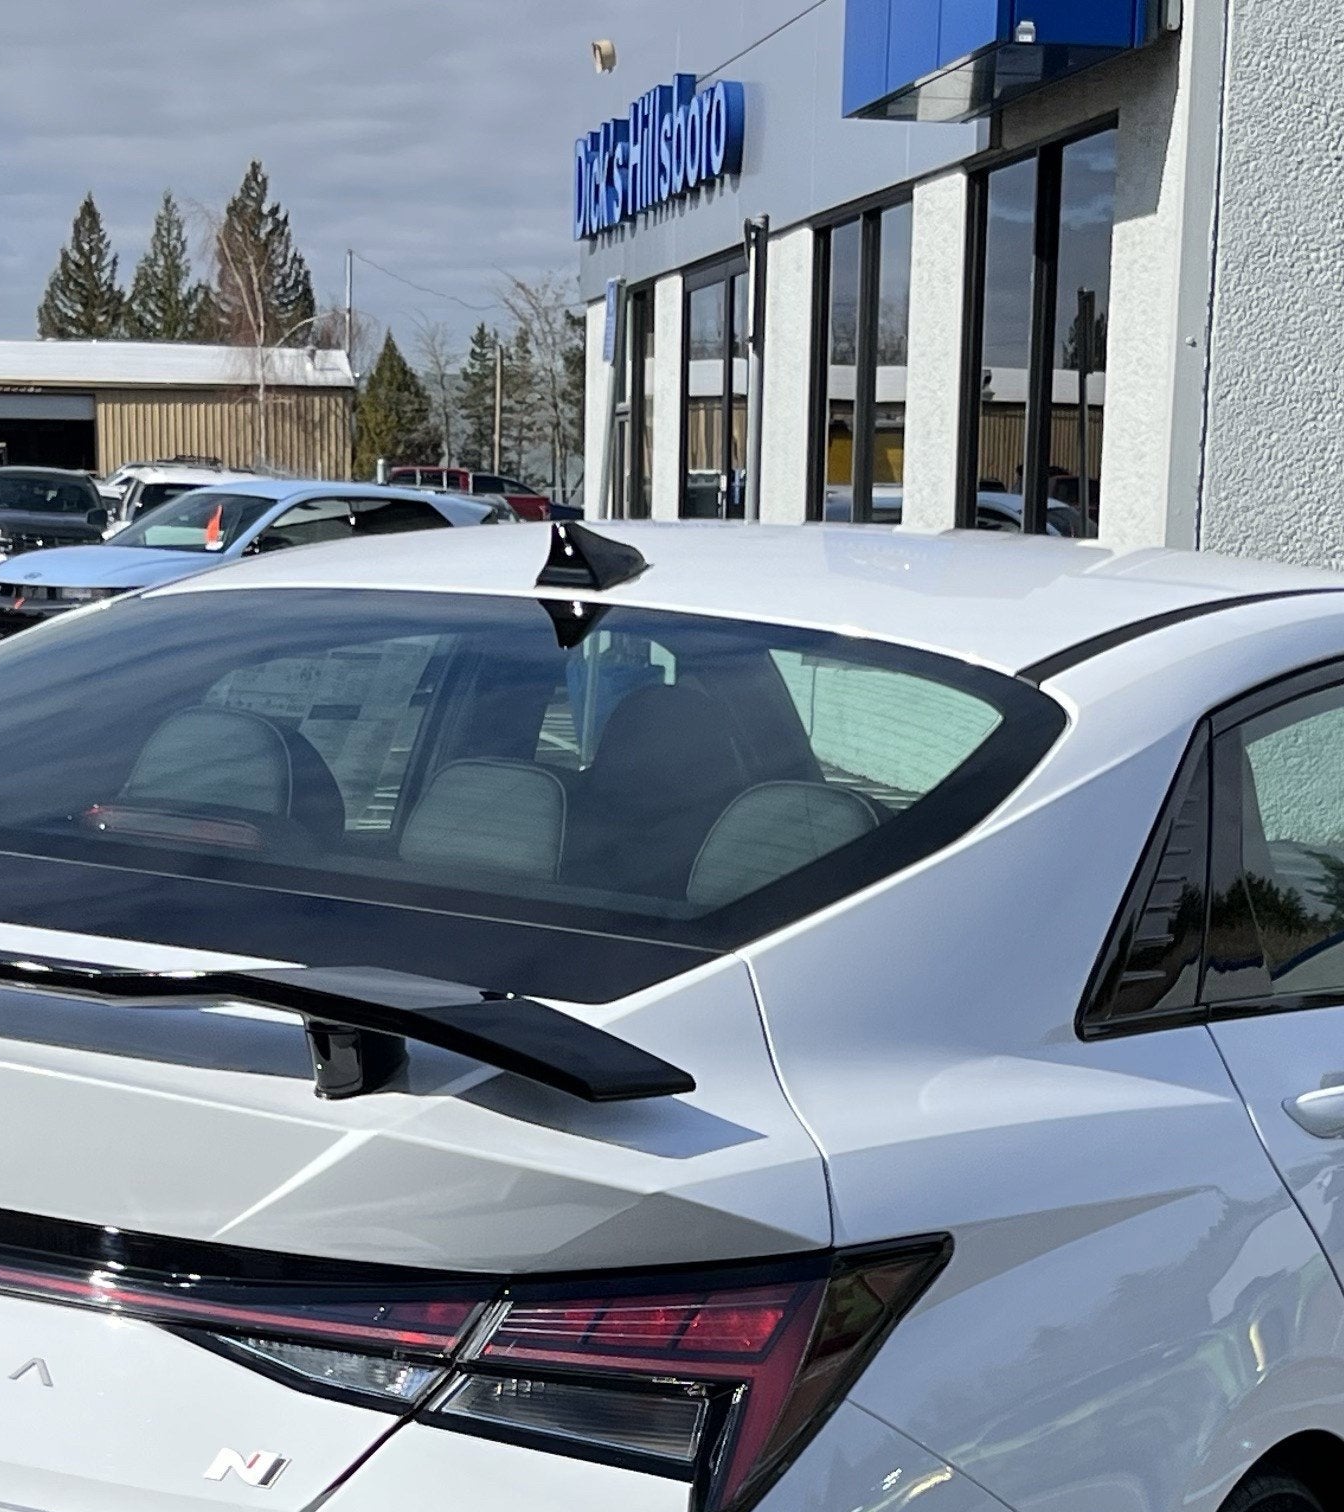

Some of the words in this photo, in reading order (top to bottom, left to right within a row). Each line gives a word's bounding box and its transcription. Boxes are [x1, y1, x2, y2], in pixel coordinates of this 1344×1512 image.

[574, 118, 627, 240] Dick's
[627, 73, 732, 216] Hillsboro
[203, 1447, 292, 1490] N
